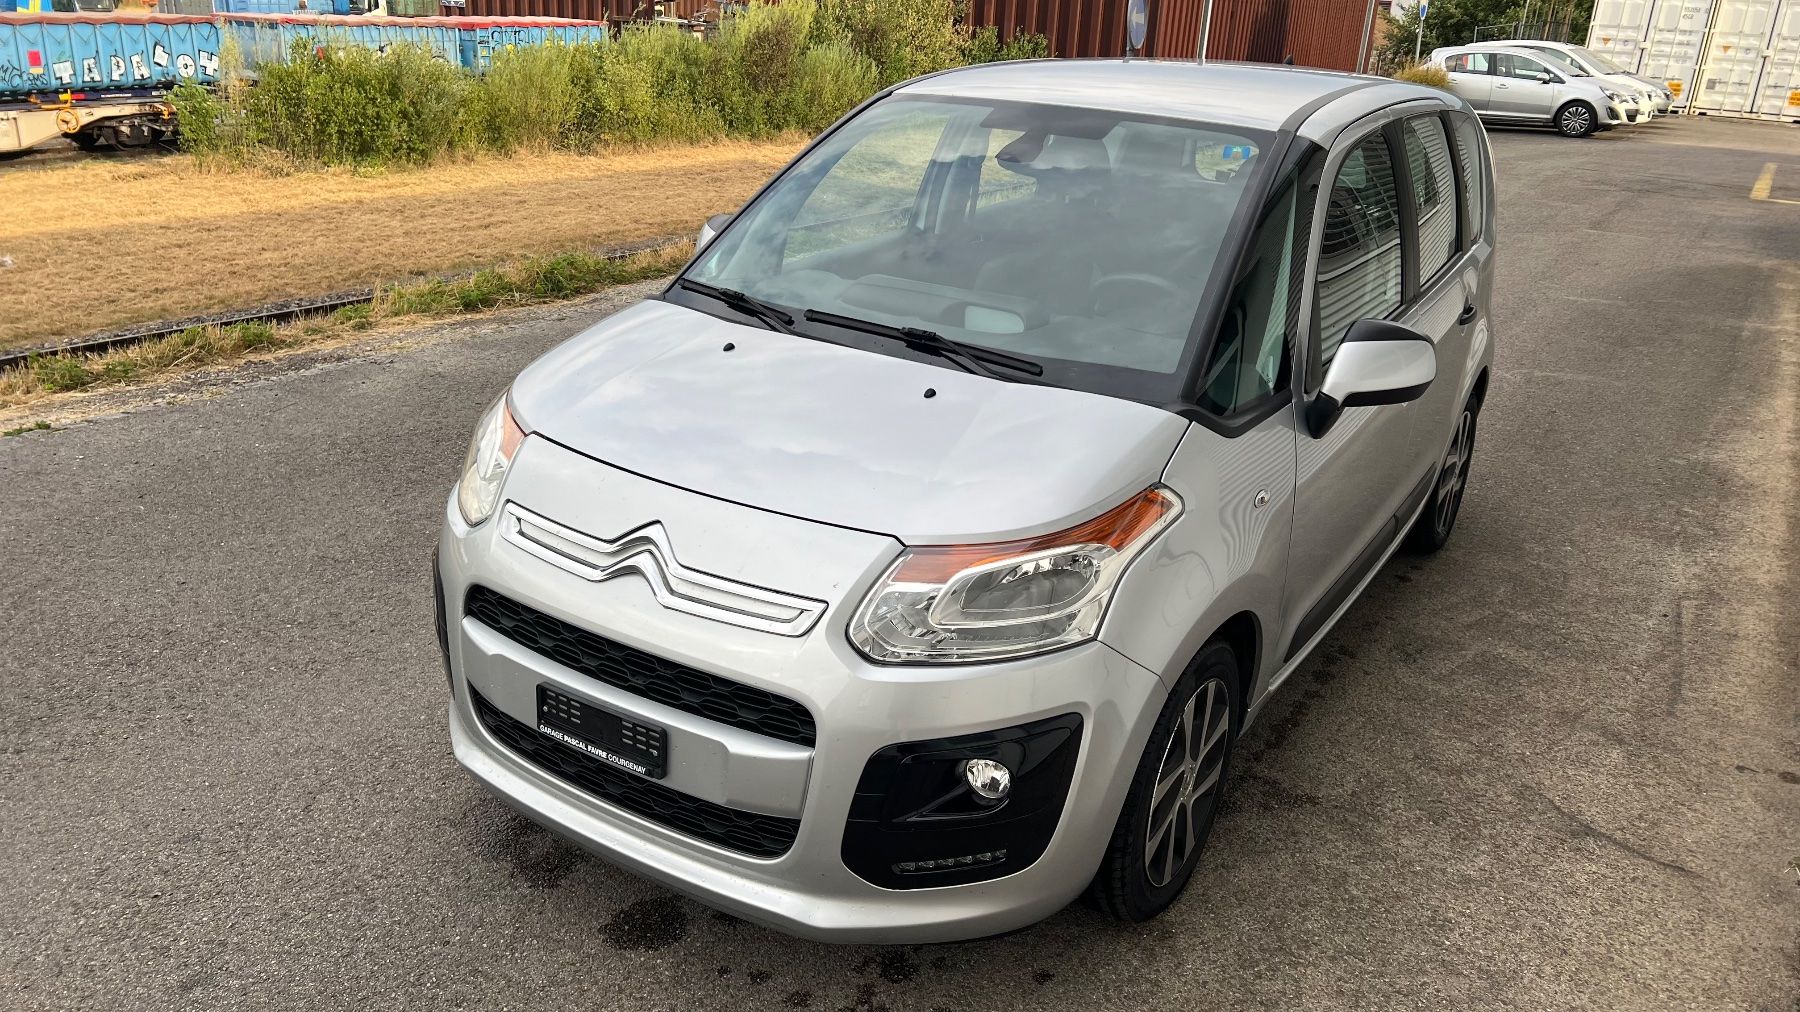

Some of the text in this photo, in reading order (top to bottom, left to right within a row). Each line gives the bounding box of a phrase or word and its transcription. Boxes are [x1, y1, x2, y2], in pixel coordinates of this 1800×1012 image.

[540, 725, 646, 774] GARAGE PASCAL FAVRE COURGENAY
